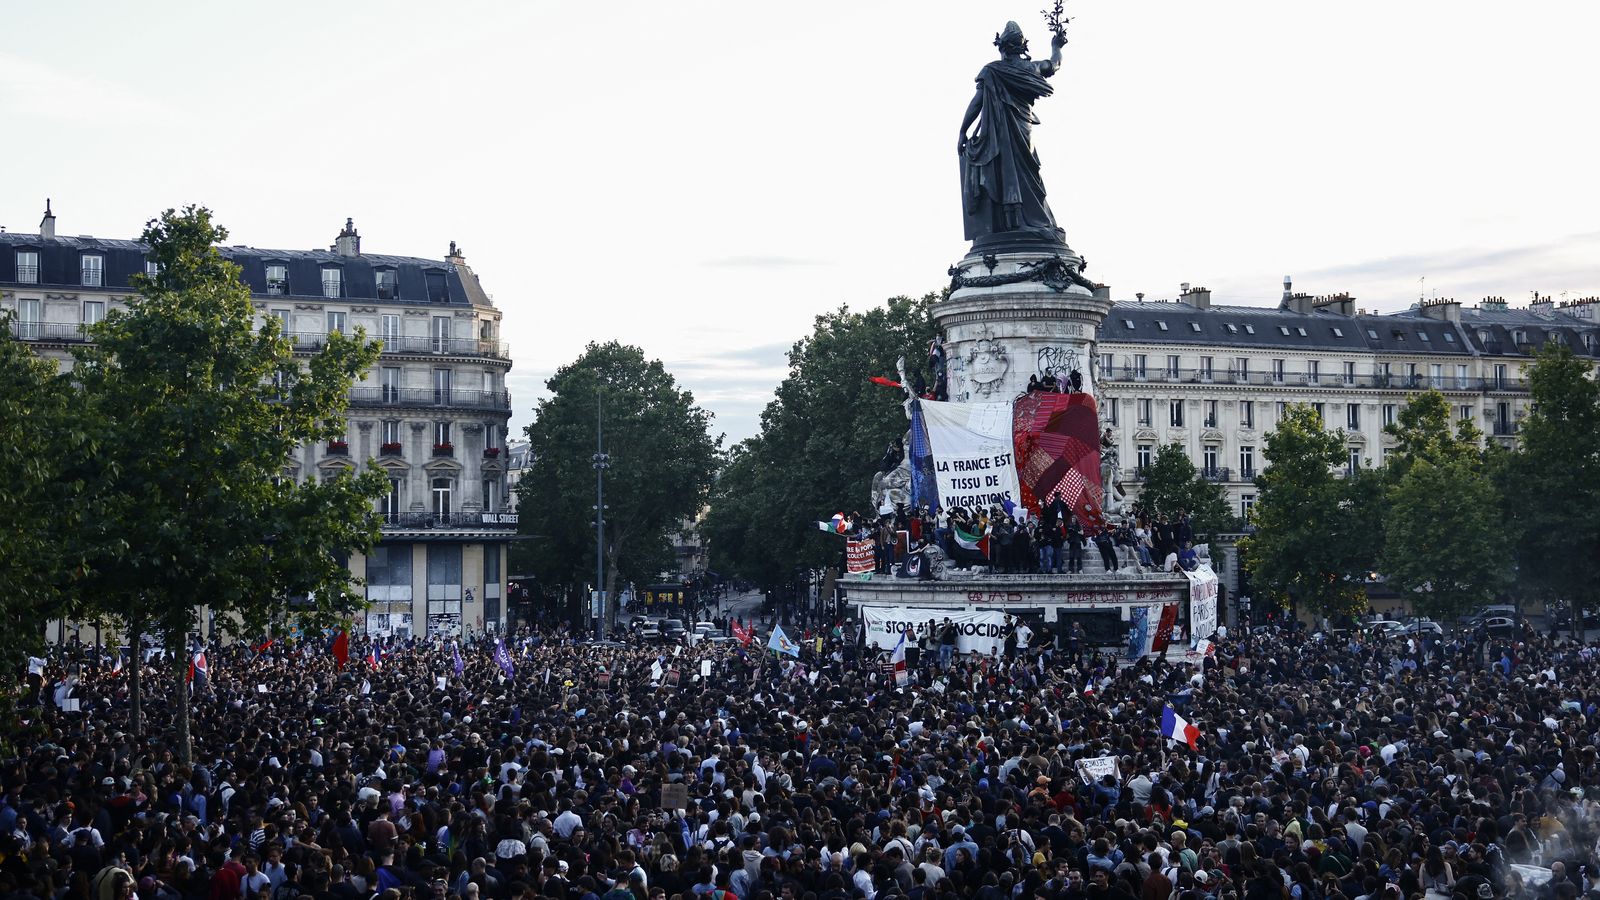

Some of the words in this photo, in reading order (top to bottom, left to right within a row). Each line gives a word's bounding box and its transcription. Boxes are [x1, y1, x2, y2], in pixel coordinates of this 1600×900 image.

[936, 460, 949, 472] LA
[954, 457, 990, 472] FRANCE
[995, 453, 1012, 466] EST
[951, 476, 981, 490] TISSU
[985, 474, 999, 486] DE
[946, 490, 1011, 507] MIGRATIONS
[481, 513, 498, 524] WALL
[499, 513, 519, 524] STREET
[936, 622, 1006, 639] NOCIDE
